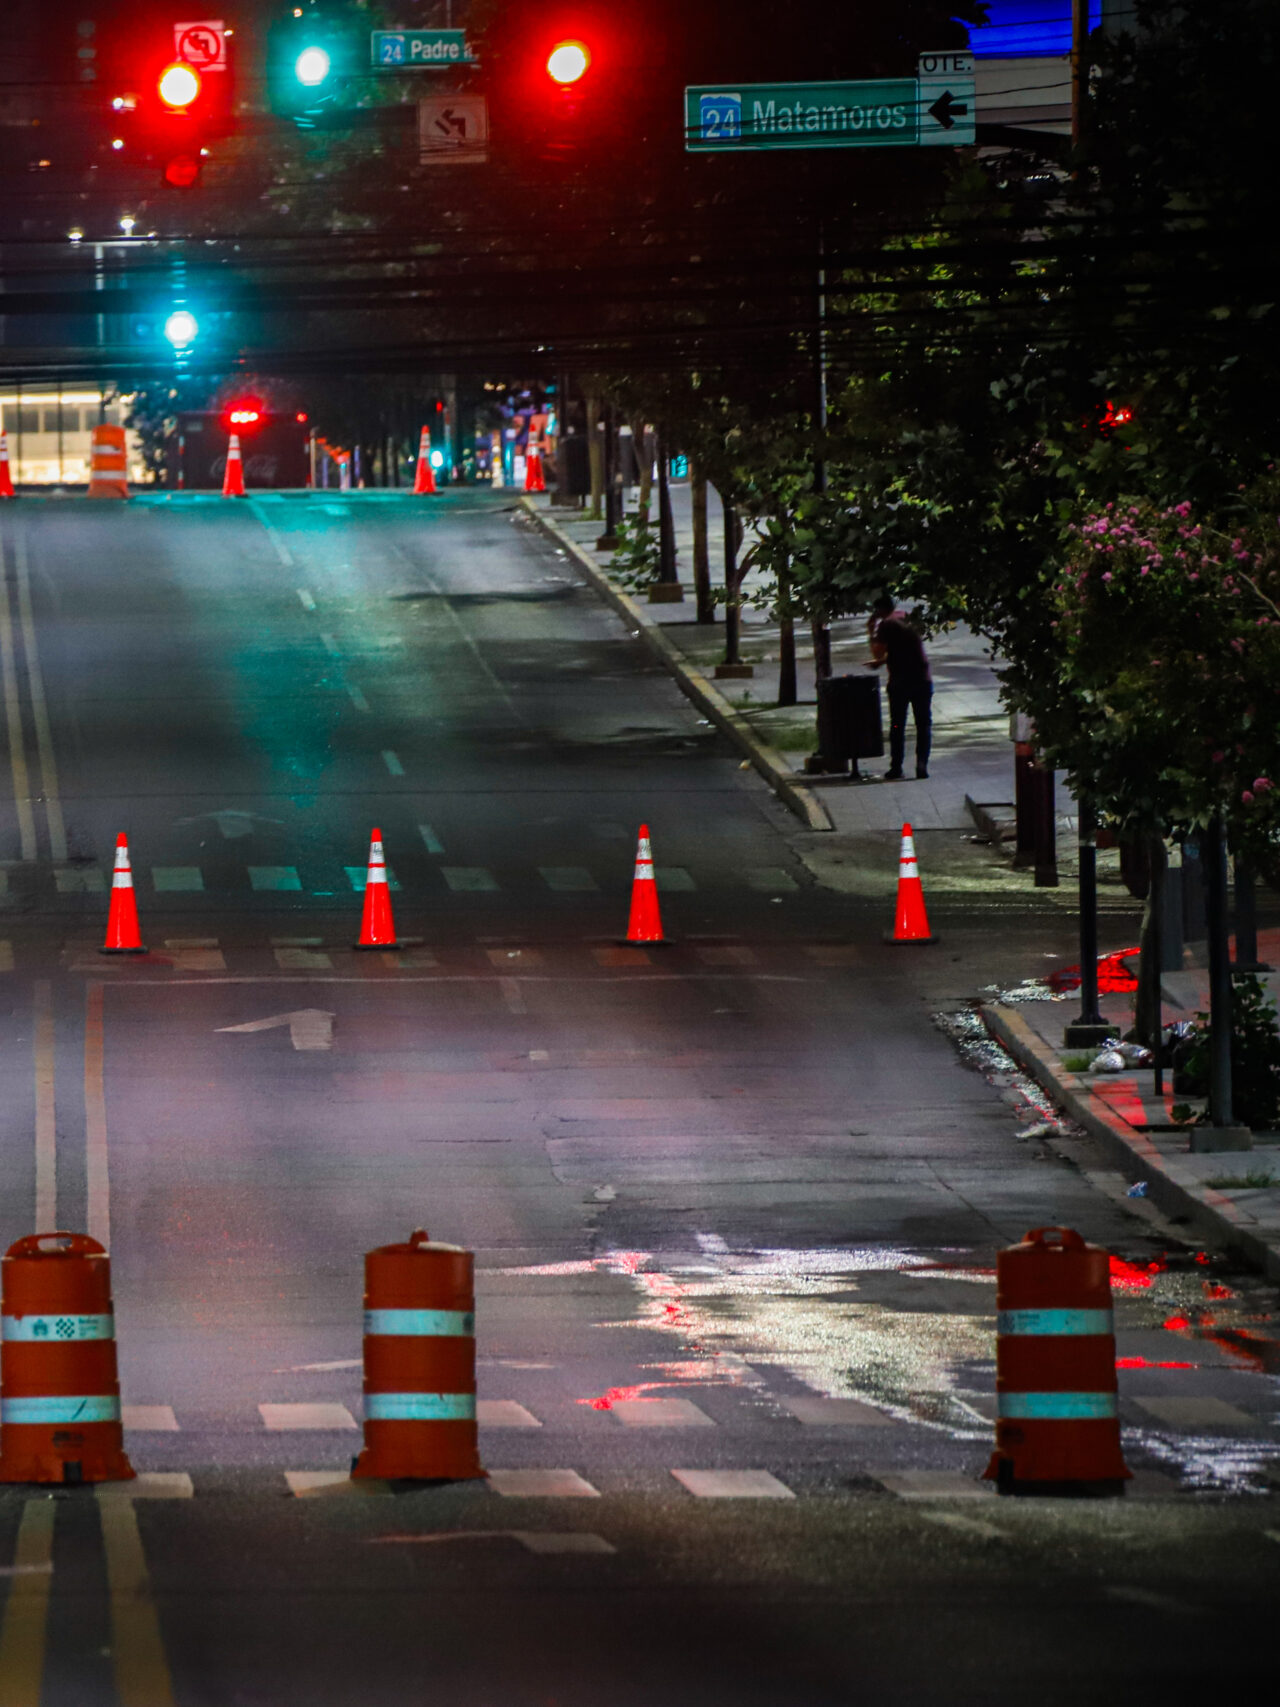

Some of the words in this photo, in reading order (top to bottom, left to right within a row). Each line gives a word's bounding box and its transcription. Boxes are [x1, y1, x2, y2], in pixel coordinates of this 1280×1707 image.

[383, 44, 403, 63] 24
[410, 39, 460, 60] Padre
[922, 55, 972, 73] OTE.
[705, 109, 738, 138] 24
[753, 99, 907, 132] Matamoros
